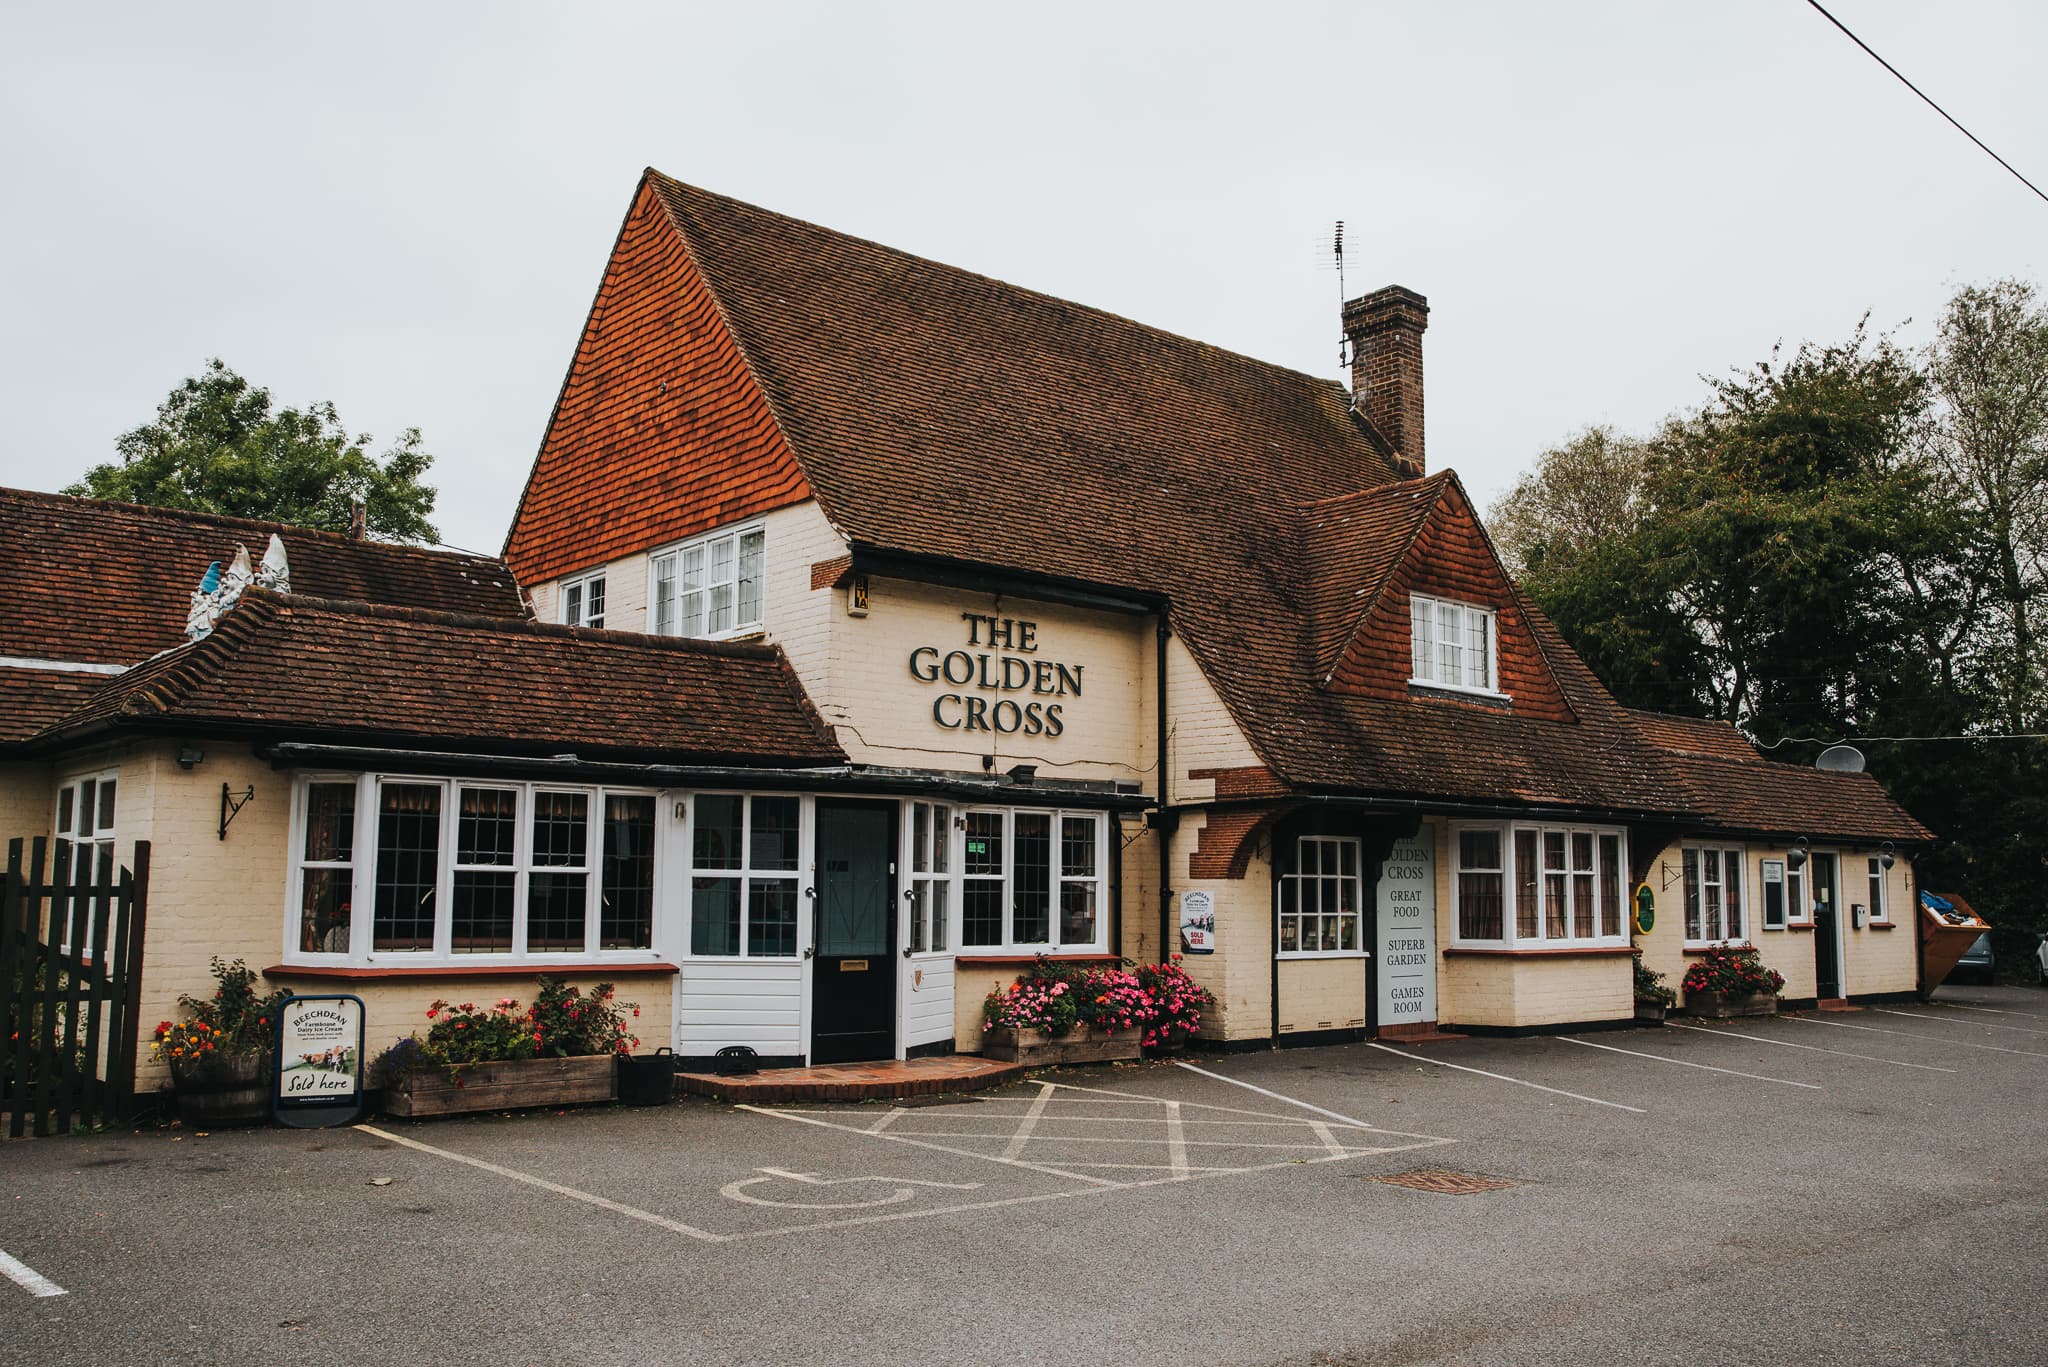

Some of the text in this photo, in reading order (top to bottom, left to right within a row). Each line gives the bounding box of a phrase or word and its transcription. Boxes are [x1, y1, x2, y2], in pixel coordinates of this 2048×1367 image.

[961, 612, 1039, 651] THE
[909, 646, 1085, 696] GOLDEN
[933, 693, 1064, 737] CROSS
[1391, 848, 1429, 862] OLDEN
[1388, 866, 1424, 880] CROSS
[1390, 890, 1422, 902] GREAT
[1393, 906, 1420, 918] FOOD
[1388, 939, 1425, 951] SUPERB
[1387, 953, 1427, 966] GARDEN
[1391, 986, 1424, 999] GAMES
[1393, 1001, 1422, 1014] ROOM
[293, 1010, 348, 1028] BEECHDEAN
[288, 1073, 348, 1092] Sold here
